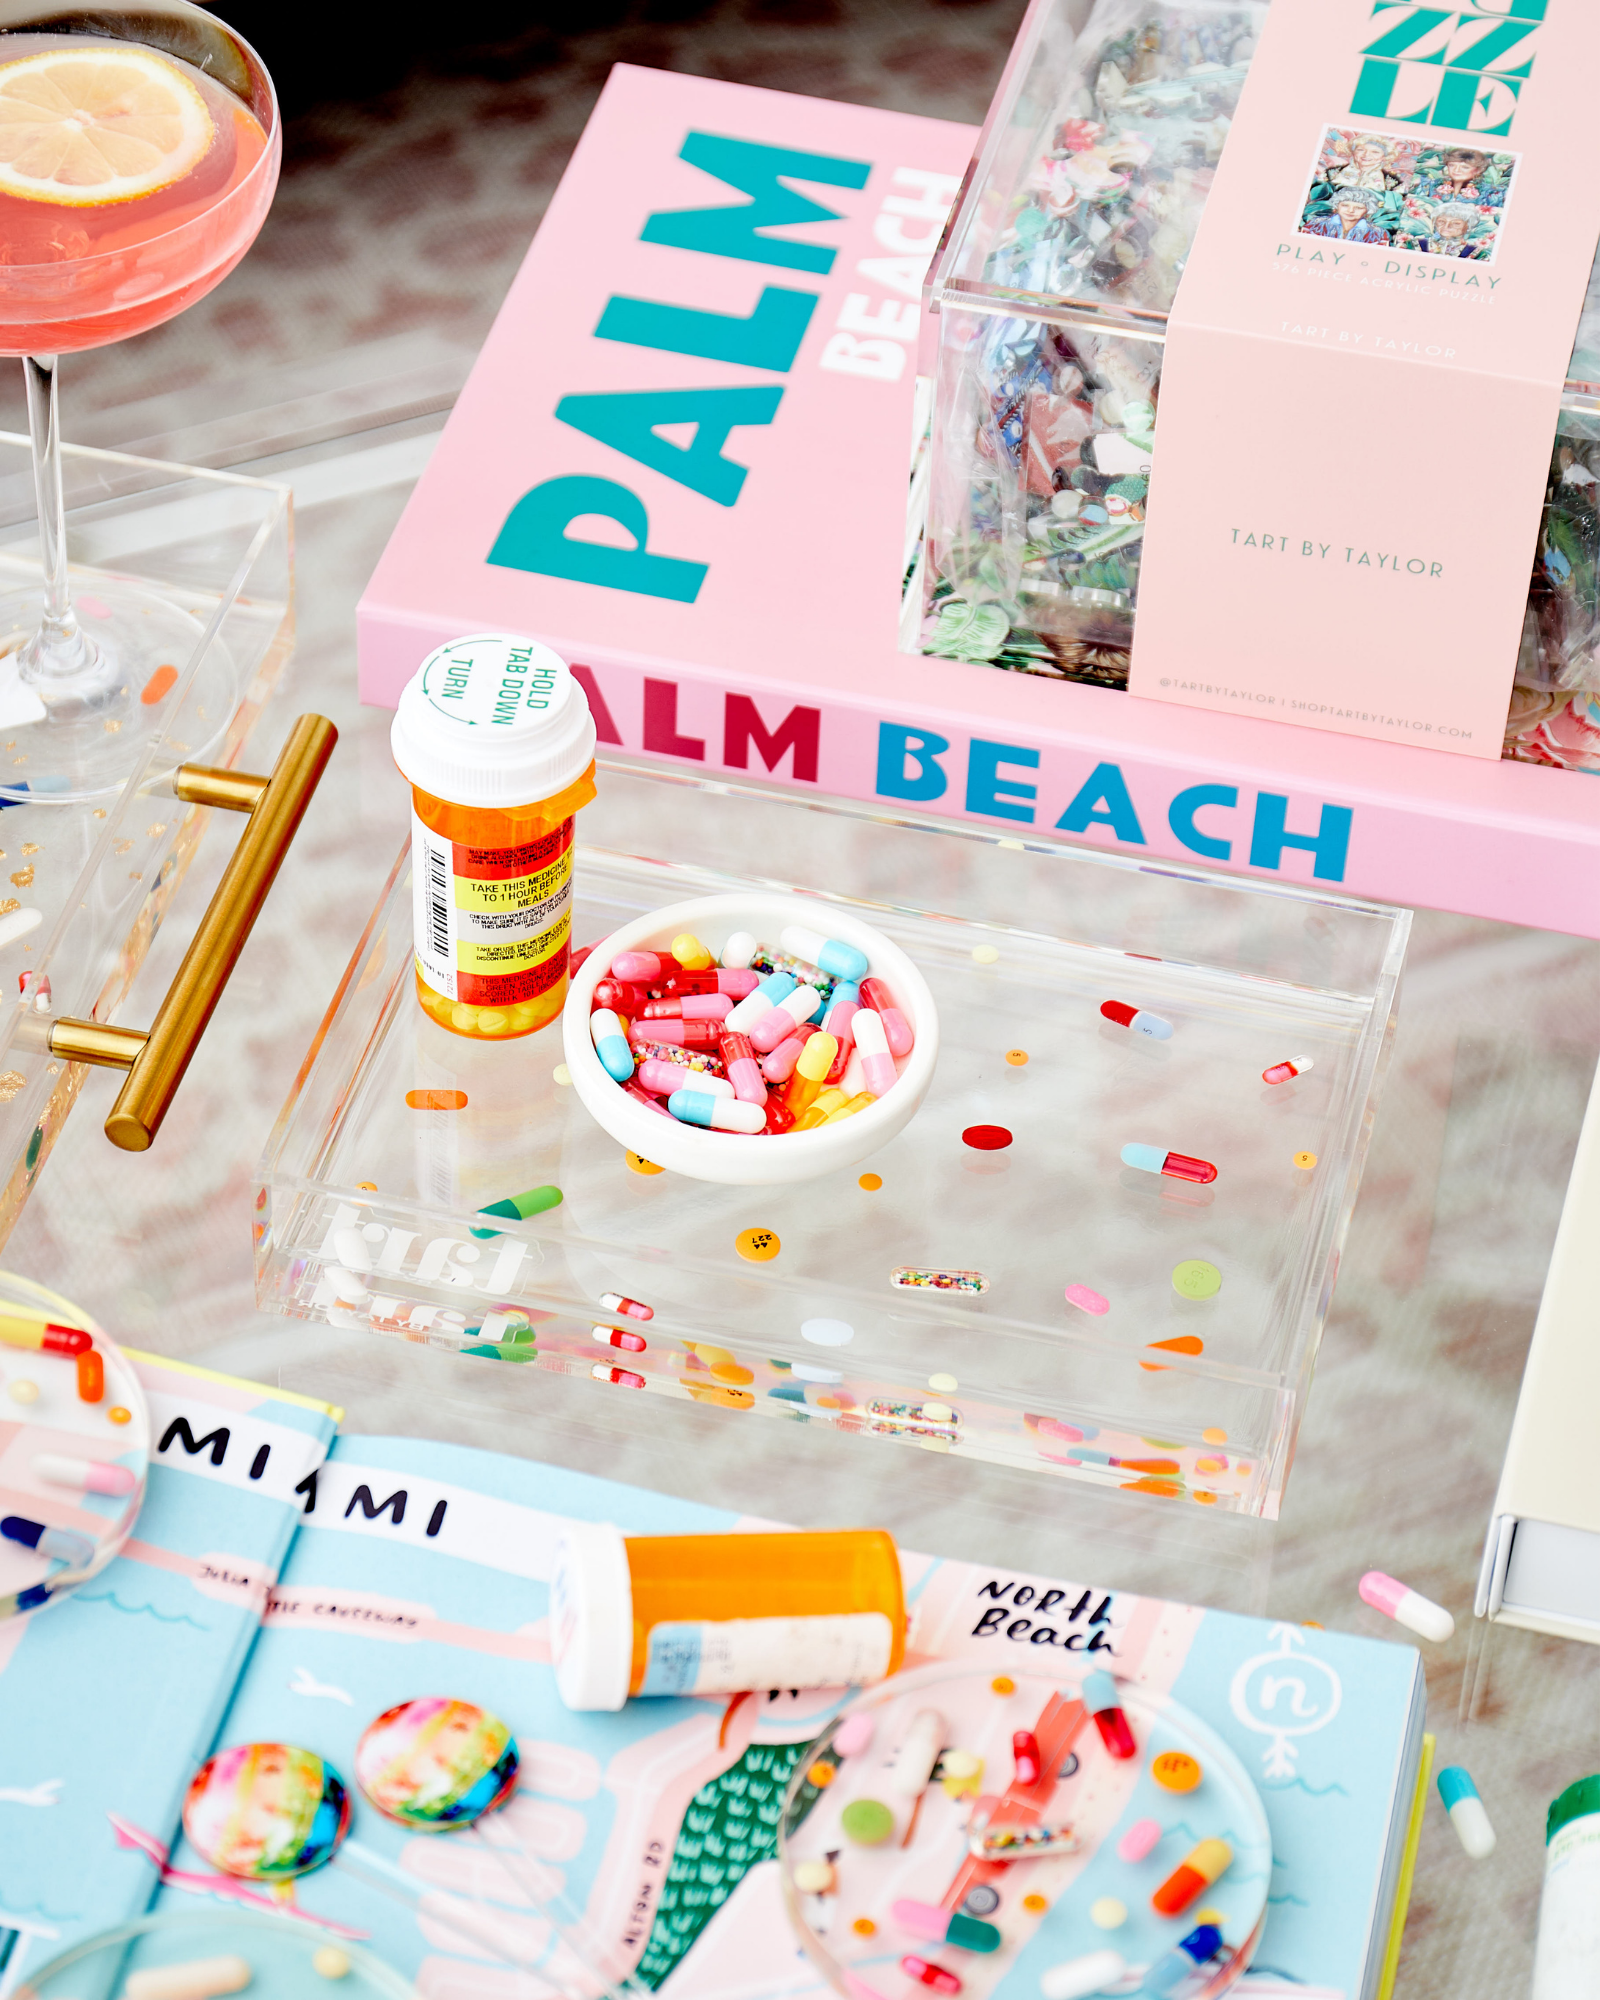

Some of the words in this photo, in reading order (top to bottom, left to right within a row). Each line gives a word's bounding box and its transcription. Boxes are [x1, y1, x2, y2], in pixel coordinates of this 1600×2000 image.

[1349, 57, 1523, 137] LE
[819, 166, 963, 382] BEACH
[1276, 243, 1346, 265] PLAY
[1384, 260, 1501, 289] DISPLAY
[1307, 267, 1353, 283] PIECE
[1360, 276, 1431, 295] ACRYLIC
[1439, 288, 1496, 305] PUZZLE
[1280, 321, 1329, 339] TART
[1339, 330, 1364, 344] BY
[1374, 336, 1457, 359] TAYLOR
[486, 129, 873, 604] PALM
[1231, 527, 1289, 553] TART
[1301, 539, 1332, 560] BY
[1344, 546, 1445, 579] TAYLOR
[441, 659, 474, 699] TURN
[506, 647, 533, 674] TAB
[491, 678, 525, 725] DOWN
[526, 668, 557, 709] HOLD
[1159, 676, 1276, 706] @TARTBYTAYLOR
[1290, 699, 1474, 740] SHOPTARTBYTAYLOR.COM
[876, 720, 1353, 883] BEACH
[471, 883, 498, 892] TAKE
[502, 880, 525, 891] THIS
[528, 856, 565, 886] MEDICINE
[482, 893, 496, 901] TO
[508, 885, 536, 900] HOUR
[539, 862, 566, 891] BEFORE
[517, 888, 548, 908] MEALS
[501, 968, 538, 983] MEDICINE
[971, 1607, 1123, 1658] Beach
